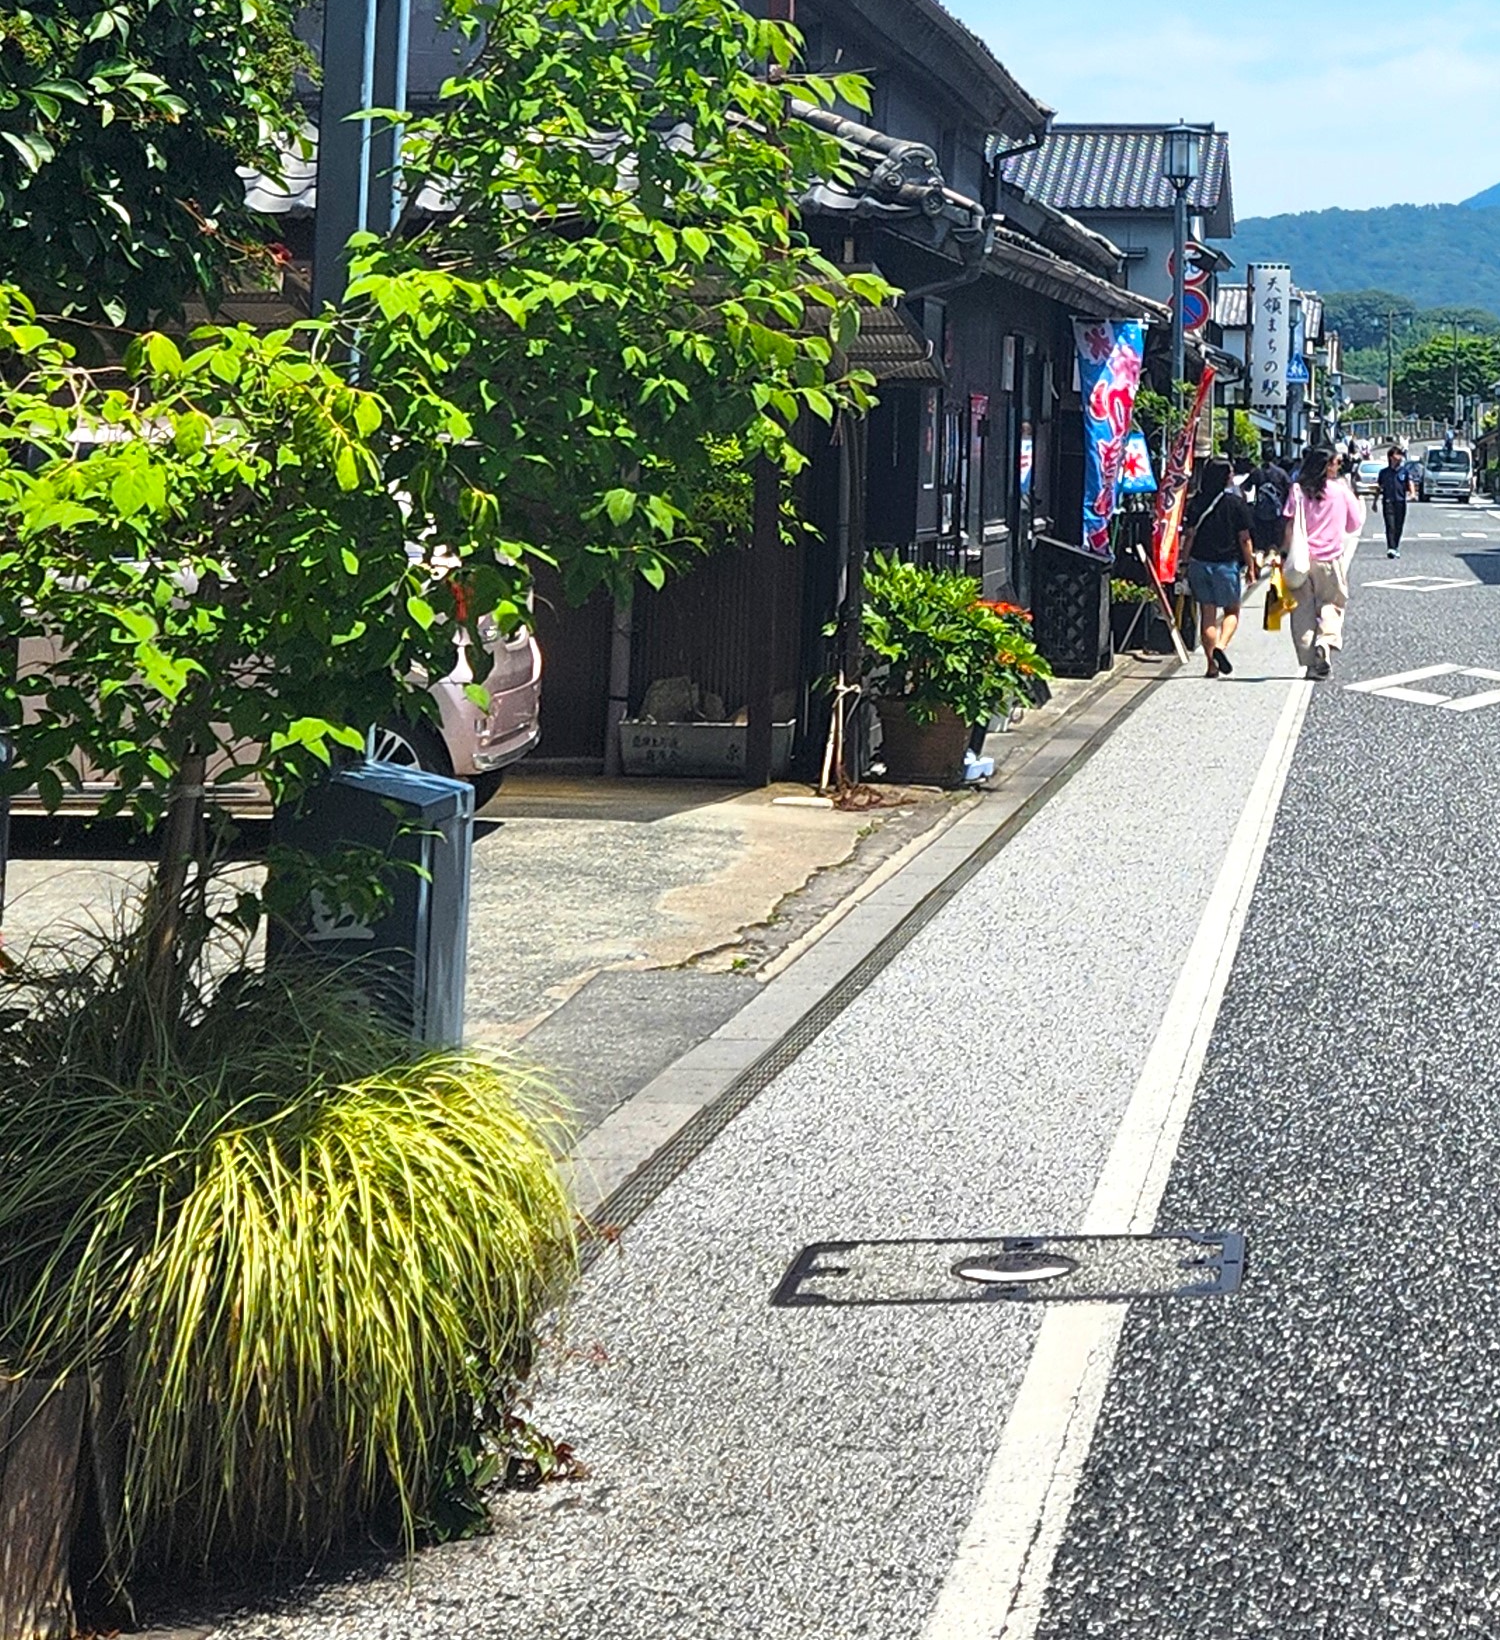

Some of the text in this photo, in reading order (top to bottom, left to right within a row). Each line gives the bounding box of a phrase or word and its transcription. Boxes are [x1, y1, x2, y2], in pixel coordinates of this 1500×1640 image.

[1261, 277, 1282, 397] 天領まちの駅
